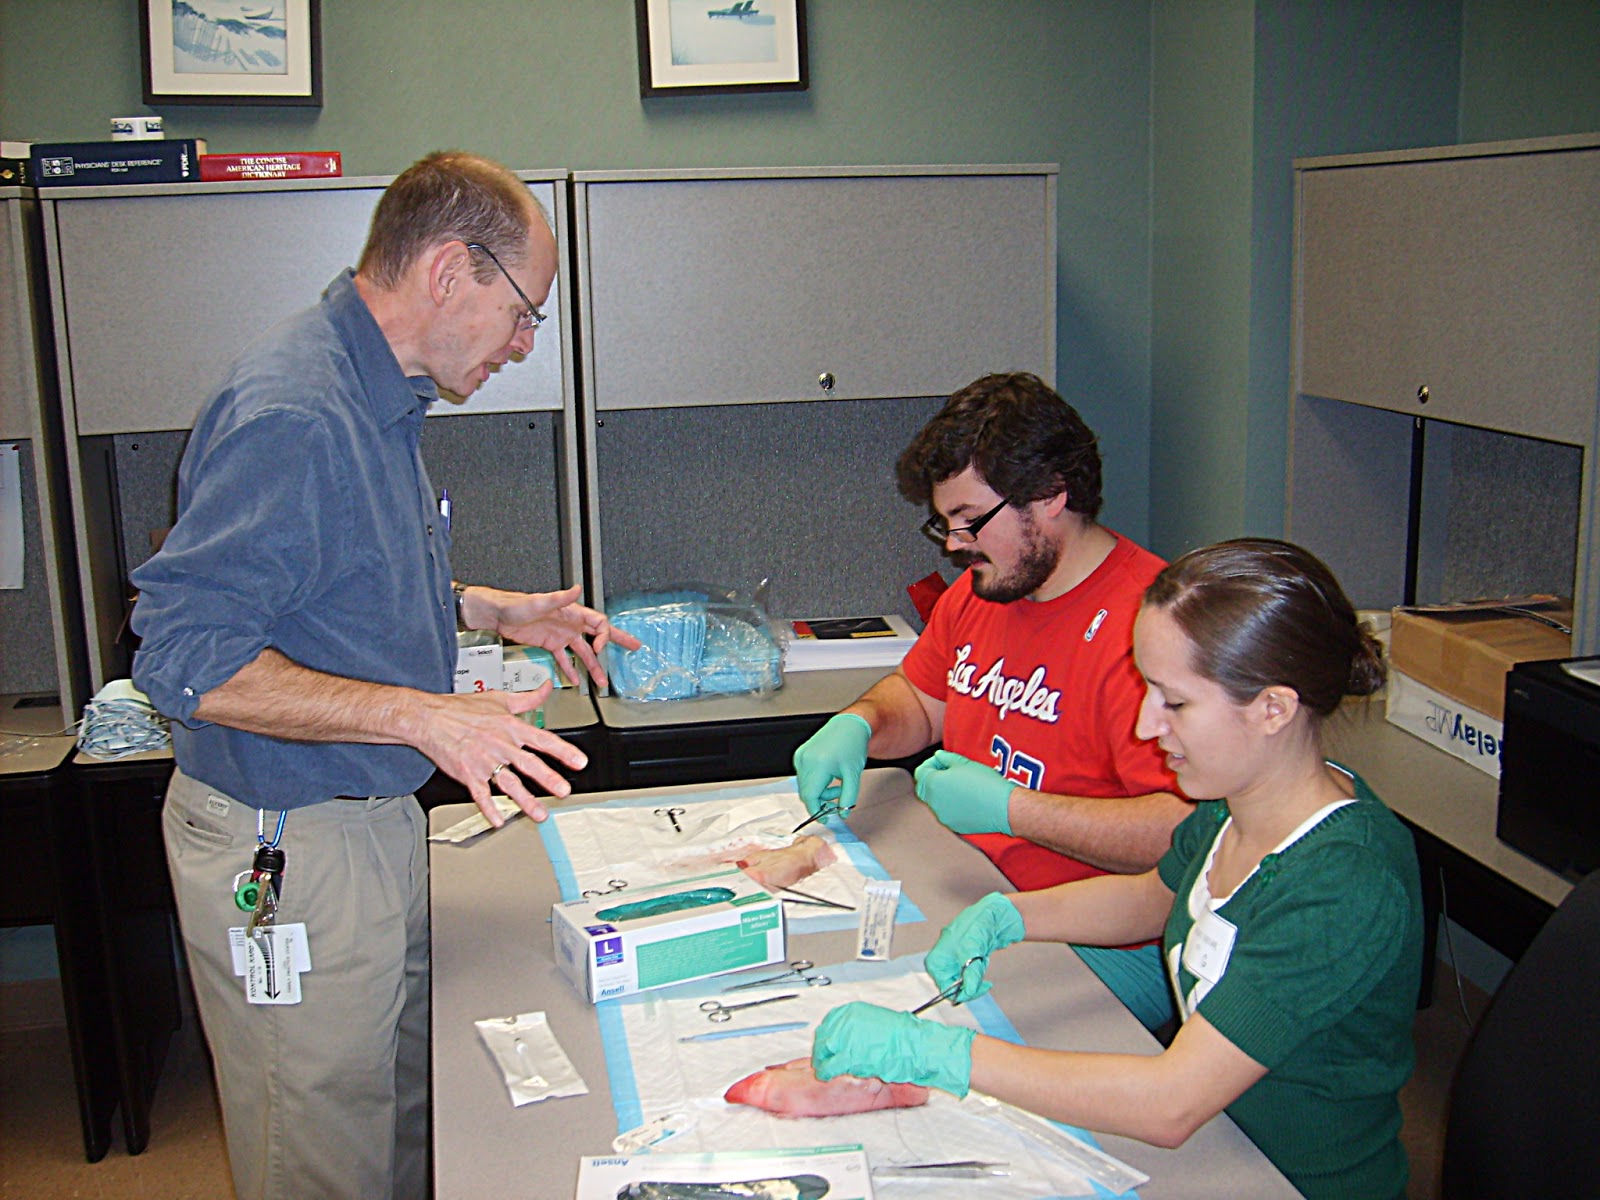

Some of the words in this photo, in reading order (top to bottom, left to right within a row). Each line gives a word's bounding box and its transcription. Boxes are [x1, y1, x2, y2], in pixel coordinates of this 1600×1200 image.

[255, 157, 287, 165] CONCISE
[226, 164, 265, 172] AMERICAN
[265, 163, 301, 171] HERITAGE
[242, 171, 286, 179] DICTIONARY
[473, 679, 485, 693] 3
[947, 643, 977, 695] Los
[971, 656, 1061, 722] Angeles
[603, 940, 614, 955] L
[601, 985, 625, 997] Ansell
